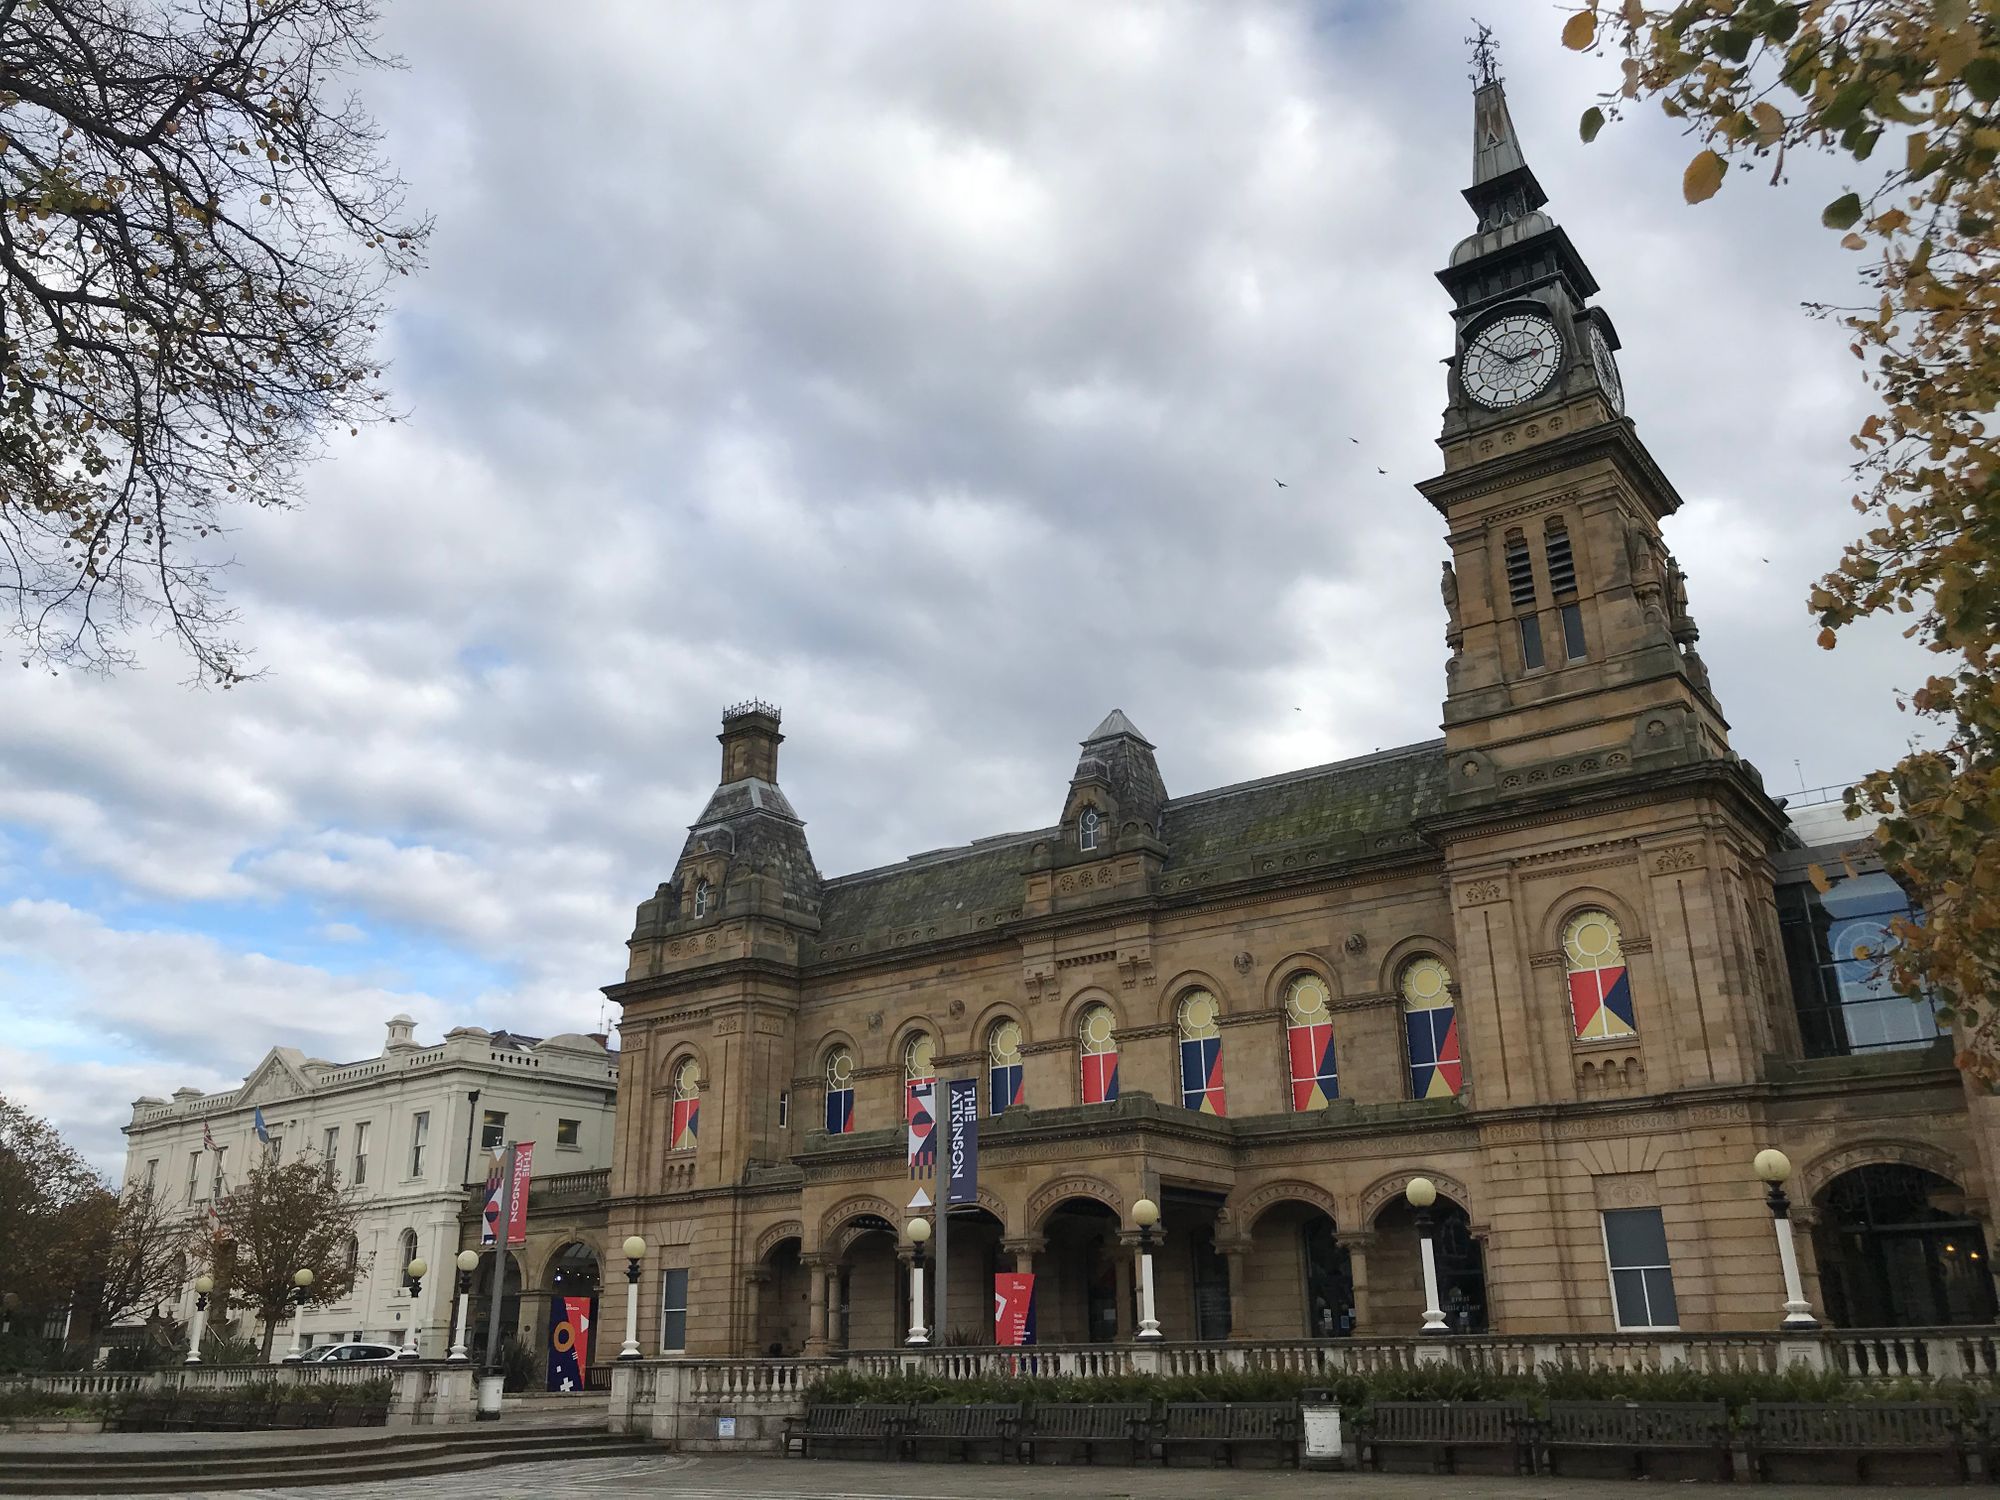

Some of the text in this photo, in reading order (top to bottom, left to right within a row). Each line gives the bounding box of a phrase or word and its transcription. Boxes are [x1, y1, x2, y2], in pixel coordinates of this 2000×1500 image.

[964, 1087, 976, 1122] THE
[951, 1089, 964, 1179] ATKINSON
[510, 1151, 523, 1223] ATKINSON
[522, 1150, 532, 1177] THE
